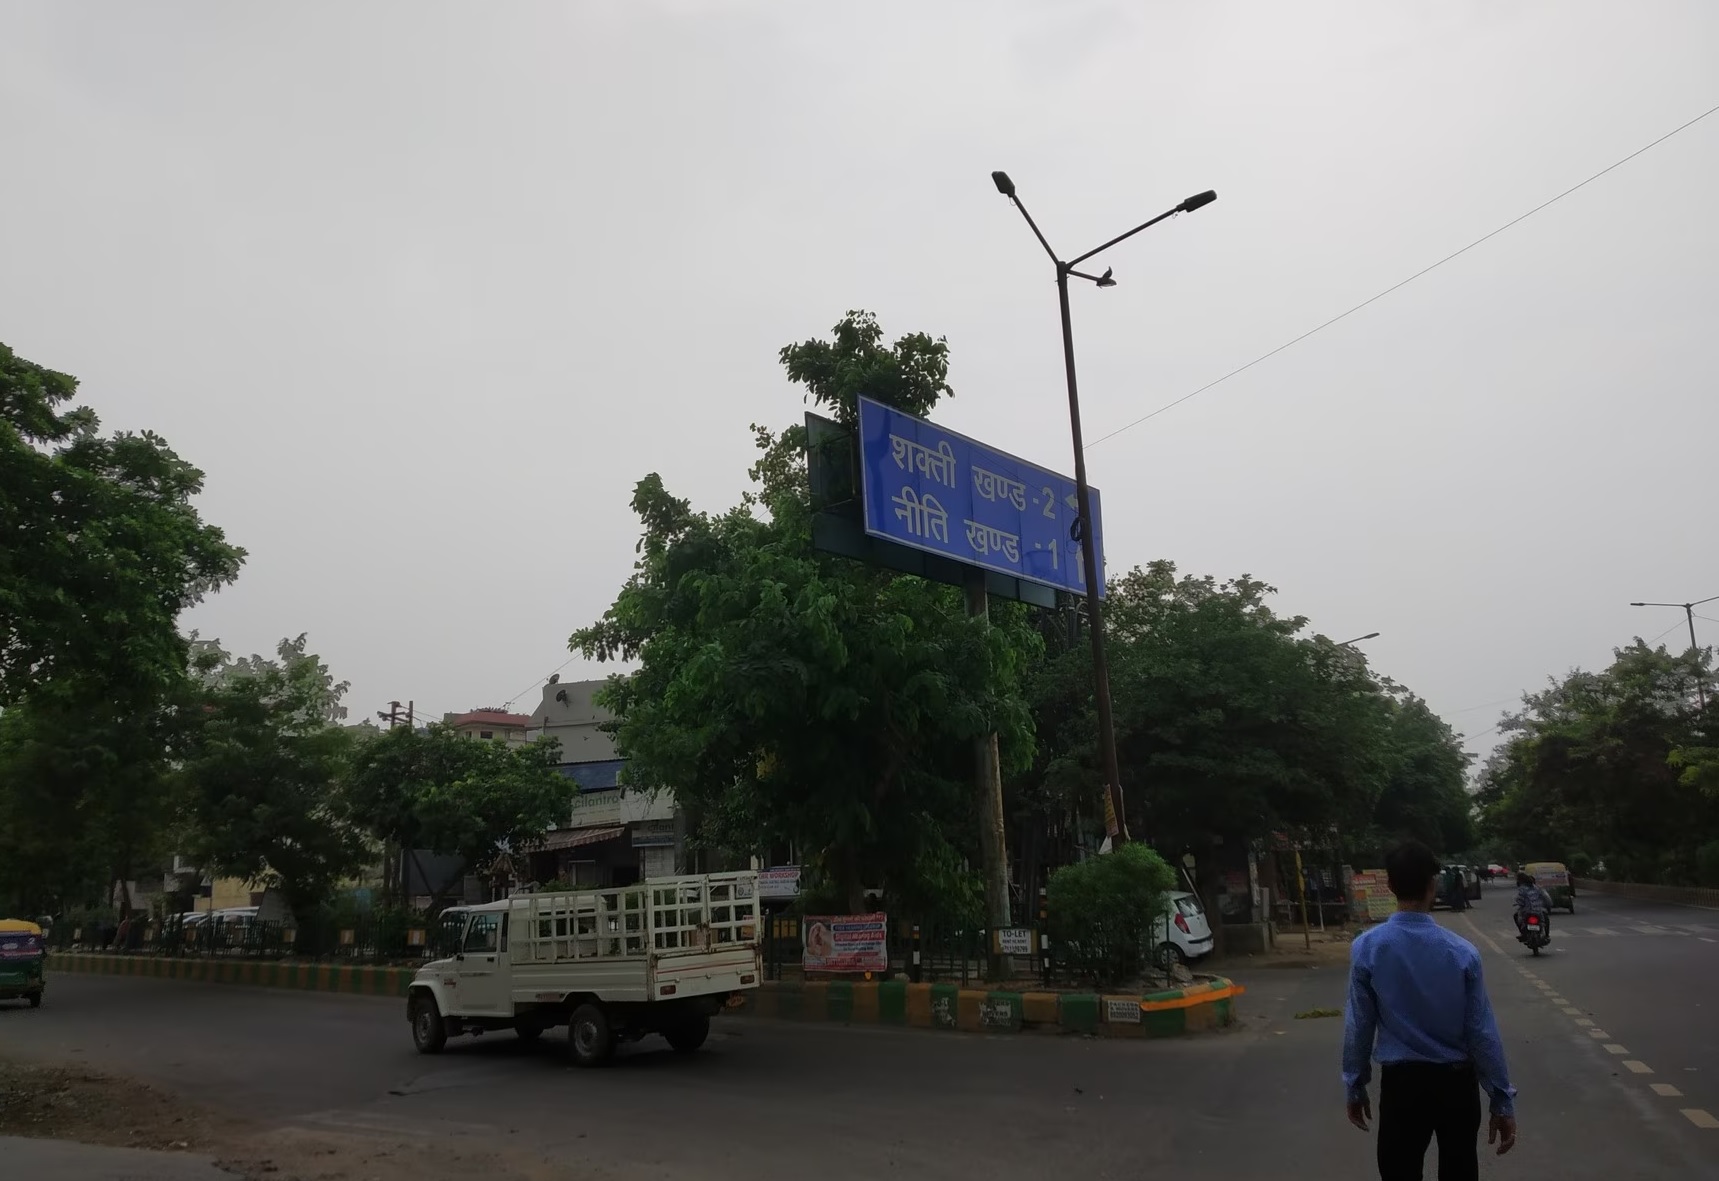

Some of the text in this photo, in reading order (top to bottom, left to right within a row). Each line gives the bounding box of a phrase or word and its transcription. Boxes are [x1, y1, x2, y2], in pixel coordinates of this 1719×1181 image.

[889, 433, 956, 489] शक्ती
[972, 465, 1026, 511] खण्ड
[892, 486, 949, 544] नीति
[964, 519, 1020, 564] खण्ड
